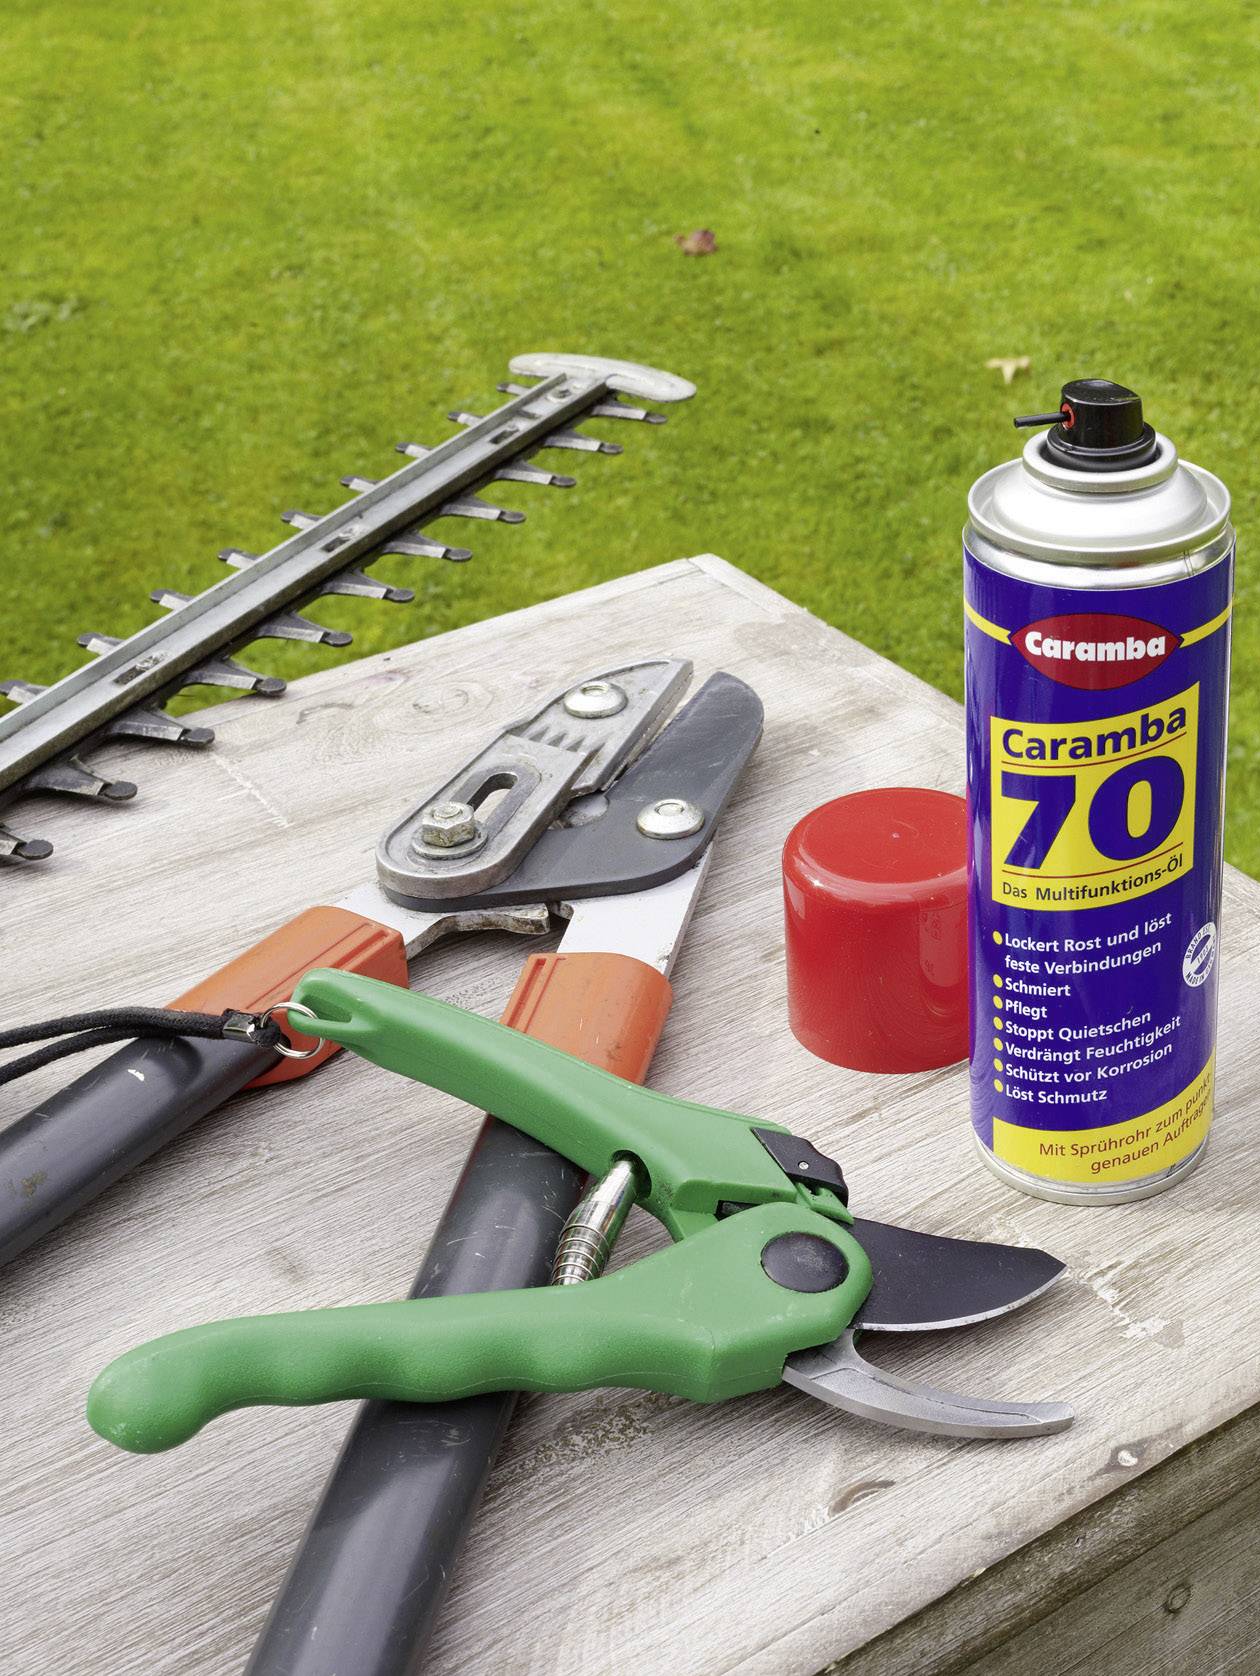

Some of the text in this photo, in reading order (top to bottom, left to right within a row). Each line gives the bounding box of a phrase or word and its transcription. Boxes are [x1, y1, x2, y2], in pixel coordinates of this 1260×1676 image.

[1025, 631, 1166, 662] Caramba
[1002, 706, 1188, 761] Caramba
[1001, 755, 1185, 870] 70
[1002, 853, 1183, 901] Das Multifunktions-Öl
[1005, 912, 1172, 952] Lockert Rost und löst
[1005, 942, 1162, 975] feste Verbindungen
[1005, 978, 1071, 997] Schmiert
[1005, 999, 1048, 1020] Pflegt
[1005, 1011, 1151, 1042] Stoppt Quietschen
[1005, 1015, 1181, 1065] Verdrängt Feuchtigkeit
[1005, 1043, 1172, 1083] Schützt vor Korrosion
[1005, 1084, 1108, 1104] Löst Schmutz
[1039, 1143, 1066, 1156] Mit
[1070, 1127, 1152, 1158] Sprührohr
[1155, 1108, 1183, 1133] zum
[1091, 1141, 1159, 1175] genauen
